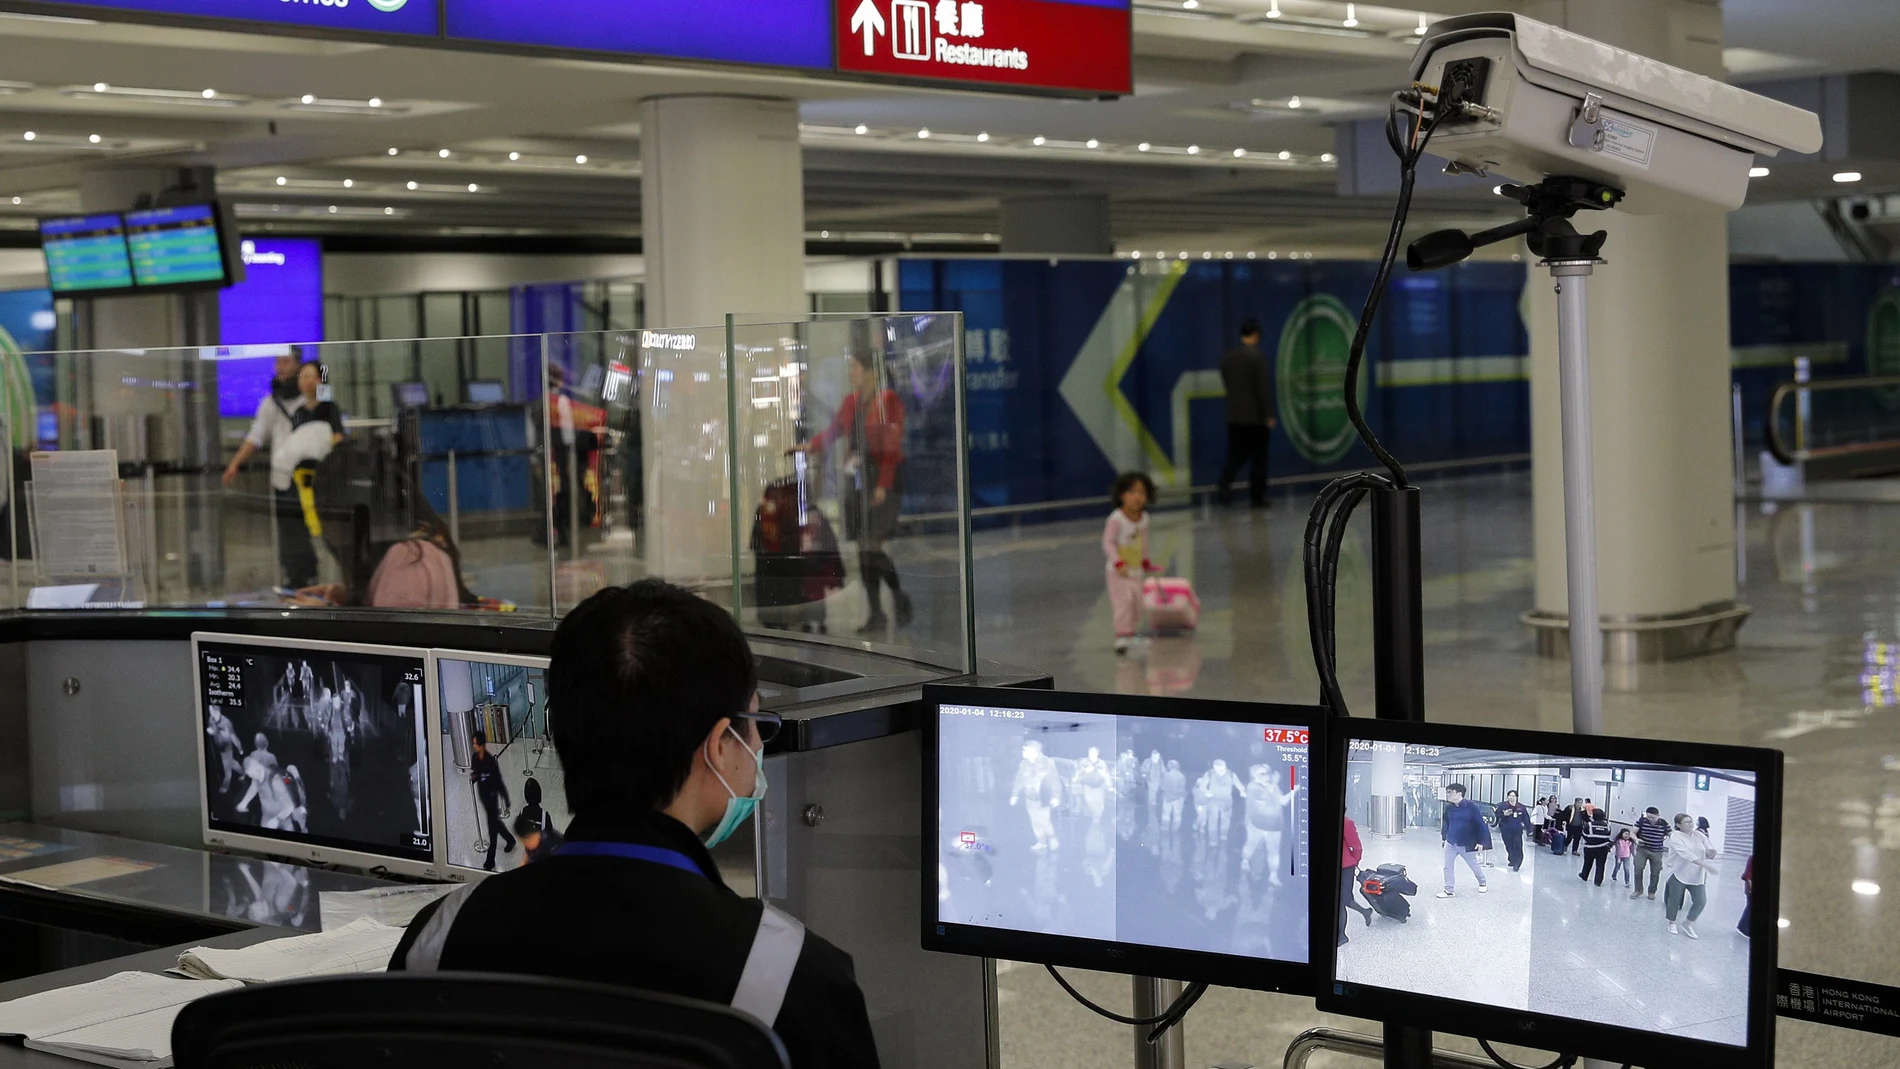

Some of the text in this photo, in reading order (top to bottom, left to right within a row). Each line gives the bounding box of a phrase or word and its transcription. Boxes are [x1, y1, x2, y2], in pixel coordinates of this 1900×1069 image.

[935, 37, 1029, 70] Restaurants
[209, 688, 234, 697] Isotherm
[940, 706, 1025, 719] 2020-01-04 12:16:23
[1276, 745, 1308, 753] Threshold
[1349, 741, 1440, 757] 2020-01-04 12:16:23
[413, 838, 427, 846] 21.0
[1788, 982, 1815, 999] 香港
[1821, 987, 1880, 1004] HONG KONG
[1822, 998, 1900, 1018] INTERNATIONAL
[1823, 1008, 1865, 1021] AIRPORT
